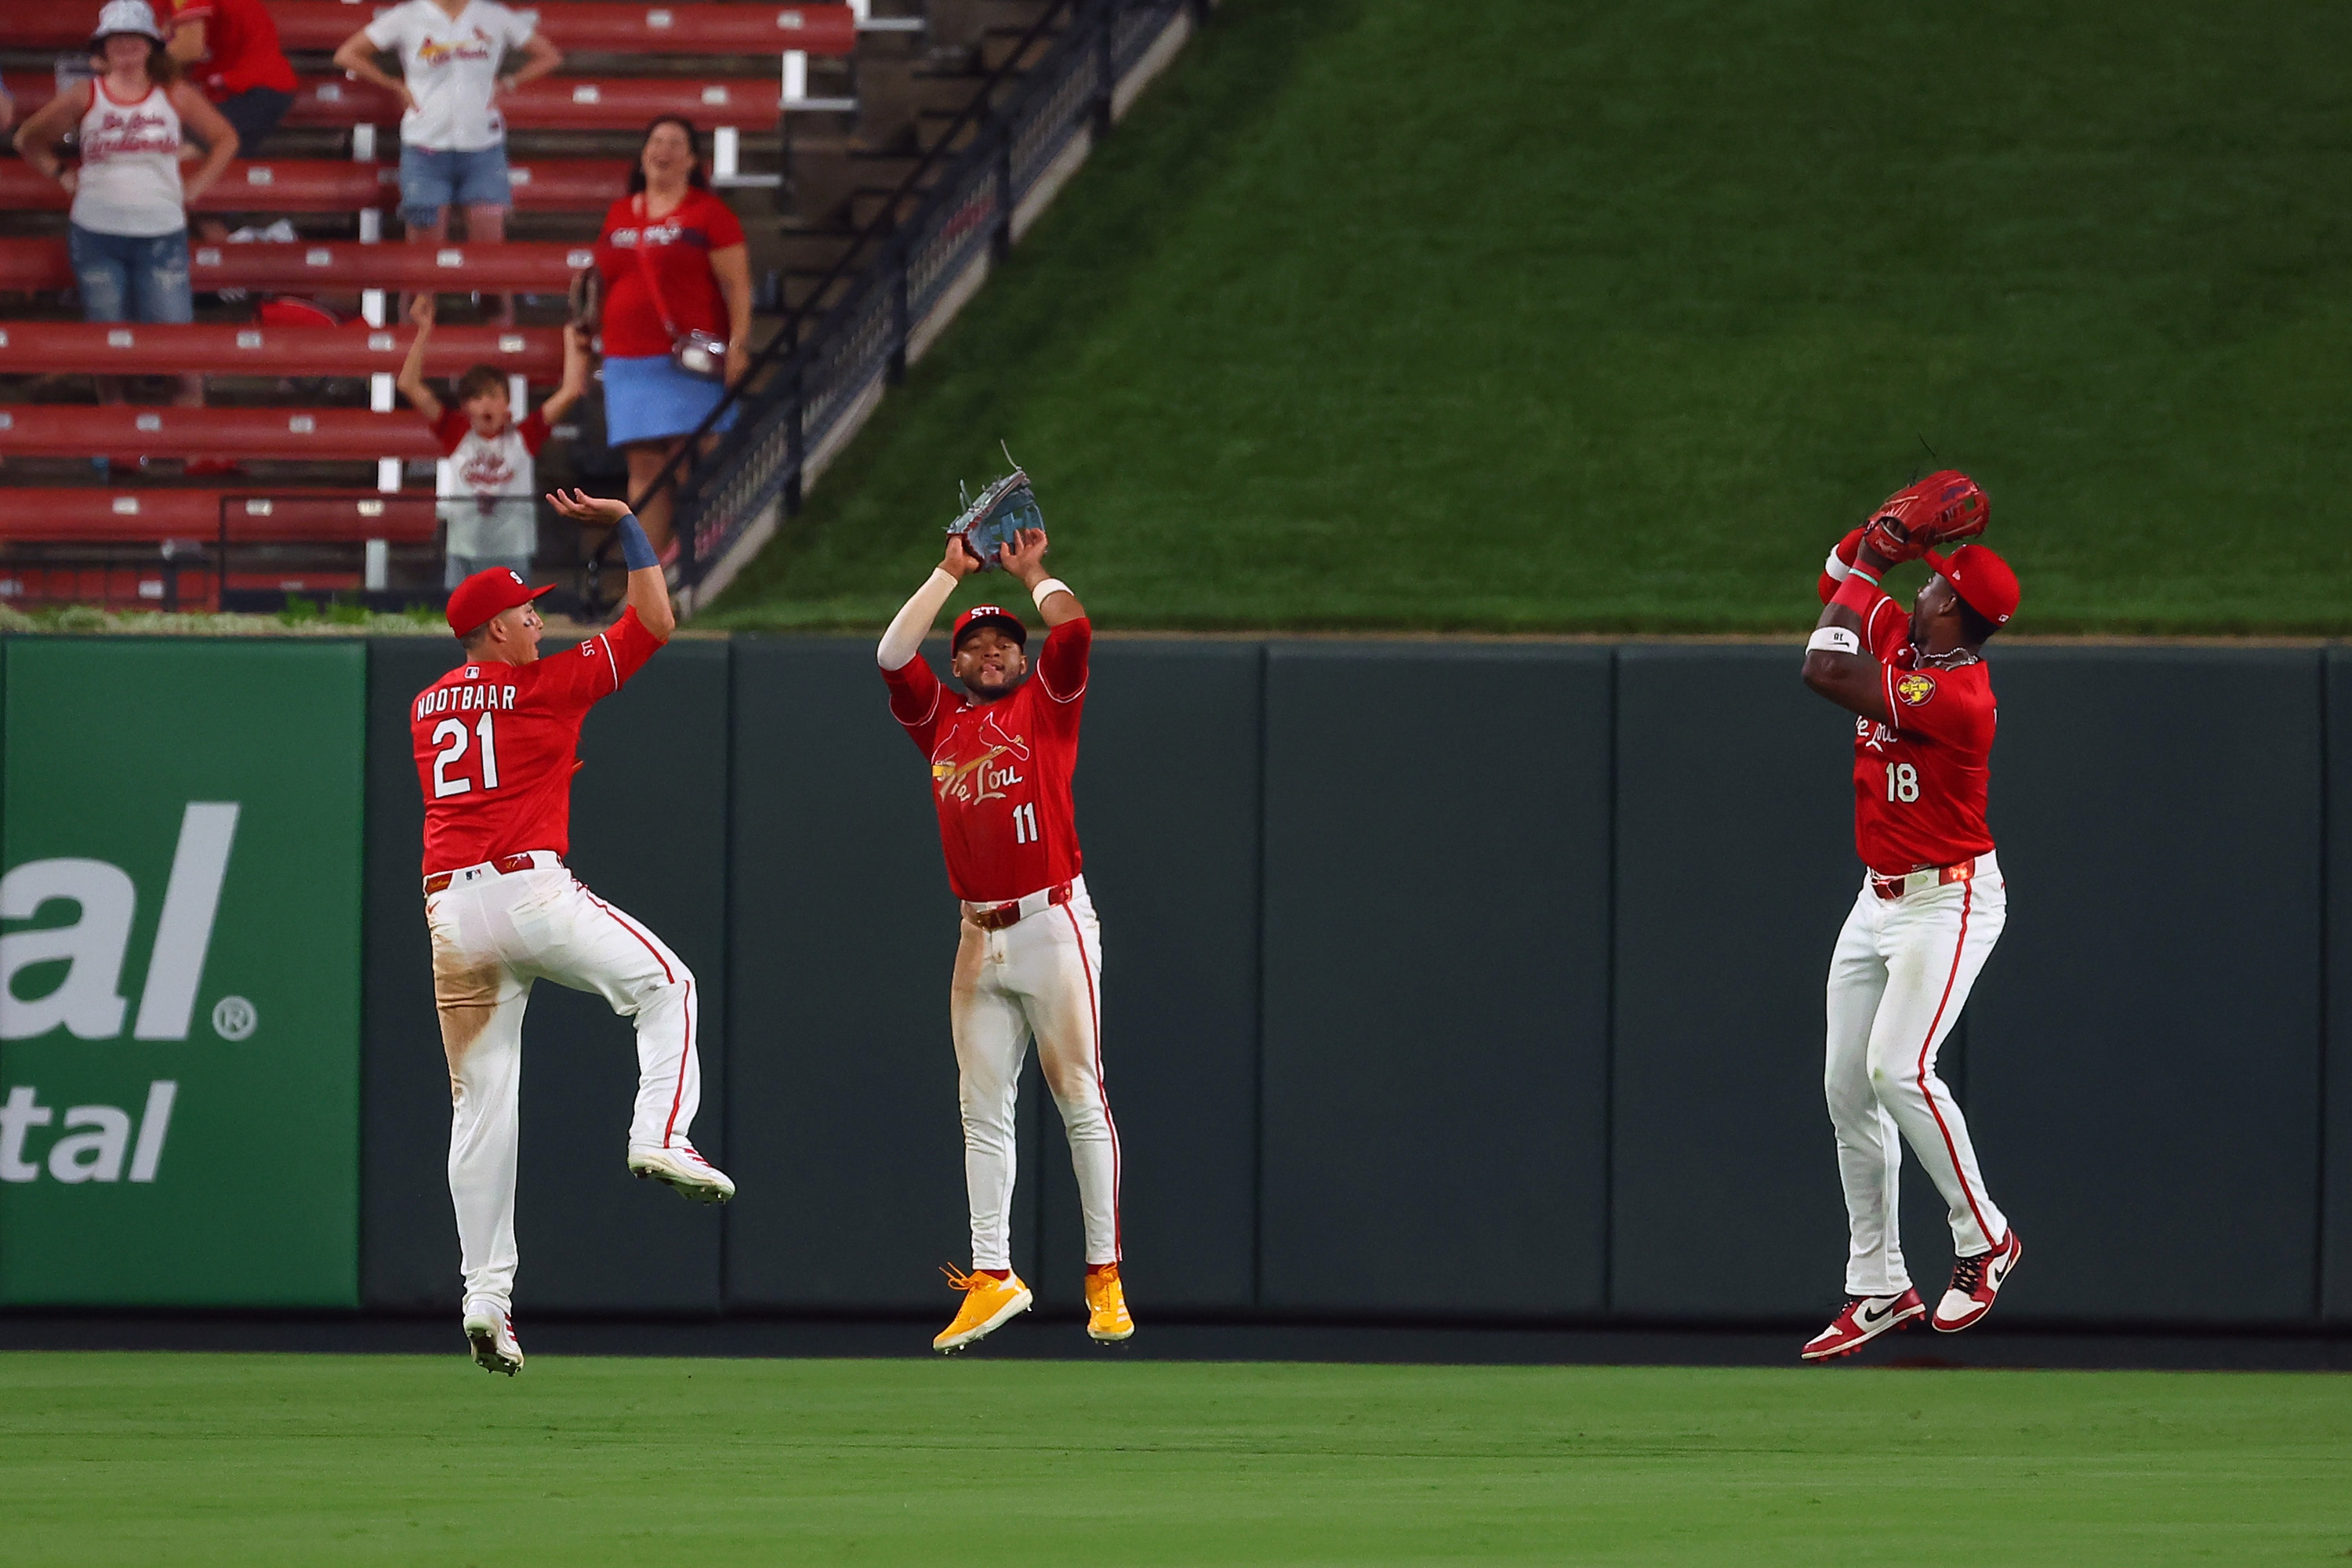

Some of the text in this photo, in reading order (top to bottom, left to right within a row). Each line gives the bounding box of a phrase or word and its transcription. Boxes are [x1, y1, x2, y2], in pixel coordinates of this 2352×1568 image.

[417, 684, 516, 722] NOOTBAAR
[432, 710, 499, 799] 21
[973, 759, 1023, 805] Lou
[1886, 761, 1919, 802] 18
[1012, 802, 1038, 844] 11
